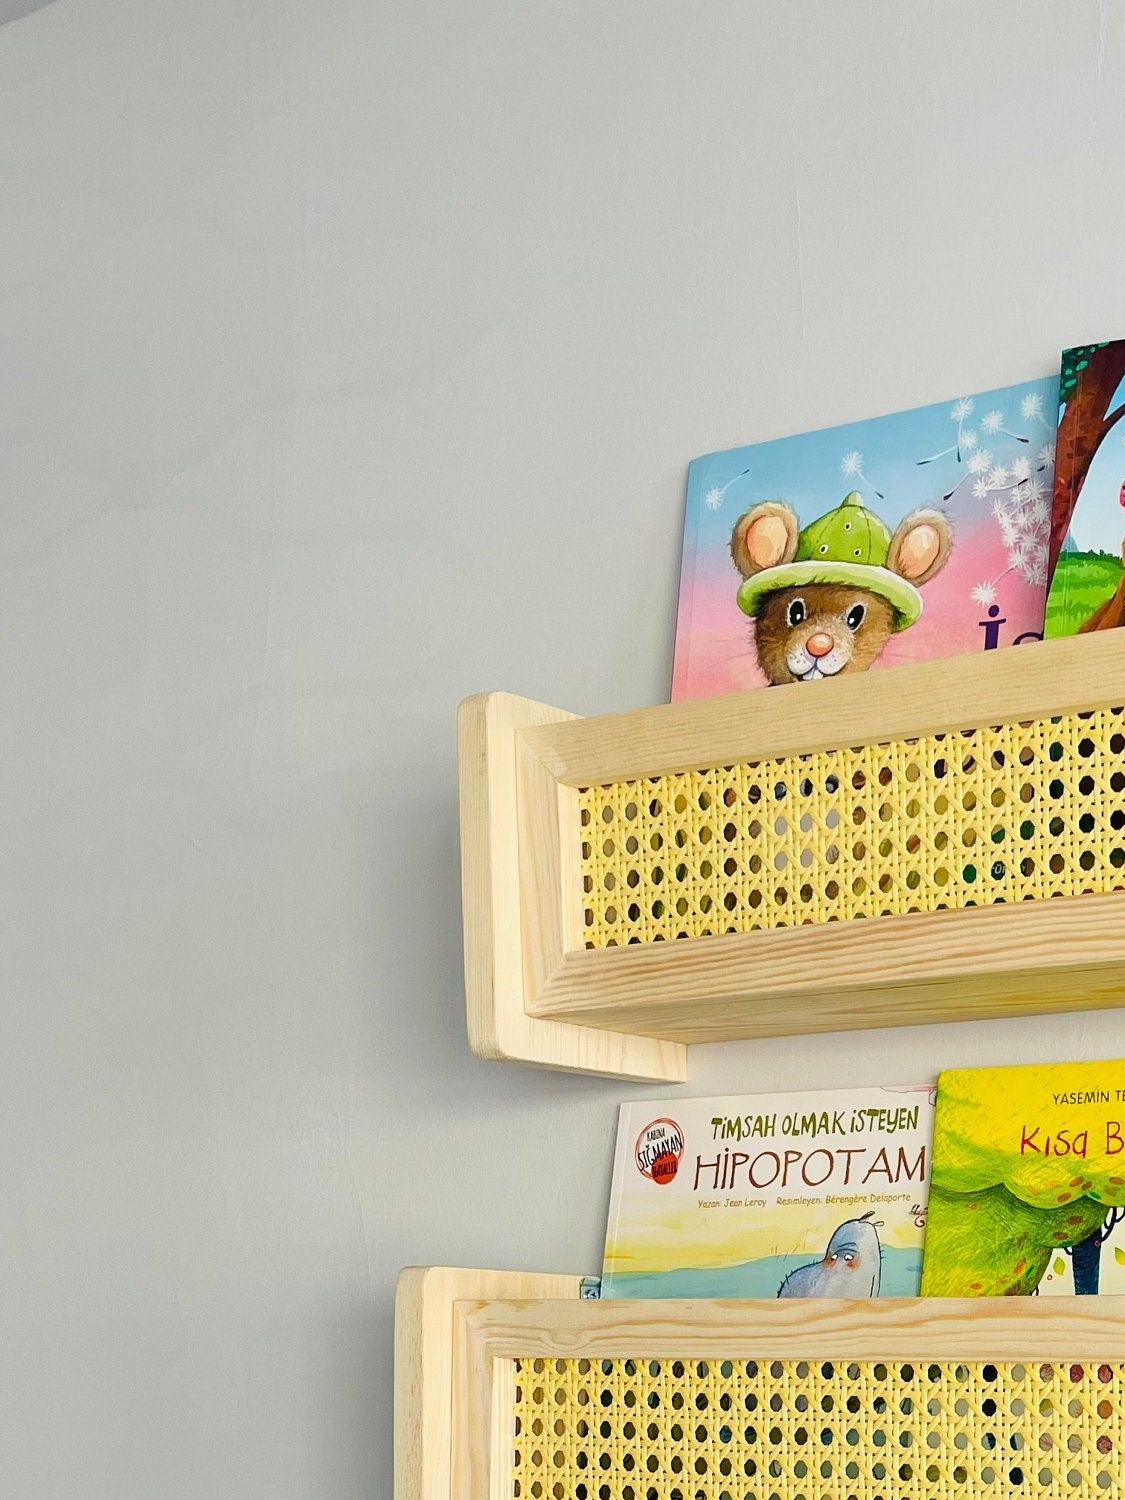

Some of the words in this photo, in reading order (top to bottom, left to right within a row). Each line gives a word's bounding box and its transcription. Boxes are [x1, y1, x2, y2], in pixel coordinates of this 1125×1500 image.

[711, 1112, 777, 1141] TİMSAH
[781, 1111, 846, 1138] OLMAK
[849, 1105, 919, 1133] İSTEYEN
[1020, 1124, 1090, 1160] Kısa
[693, 1145, 926, 1191] HİPOPOTAM
[723, 1197, 743, 1208] Jean
[744, 1197, 768, 1209] Leroy
[869, 1192, 912, 1205] Delaporte
